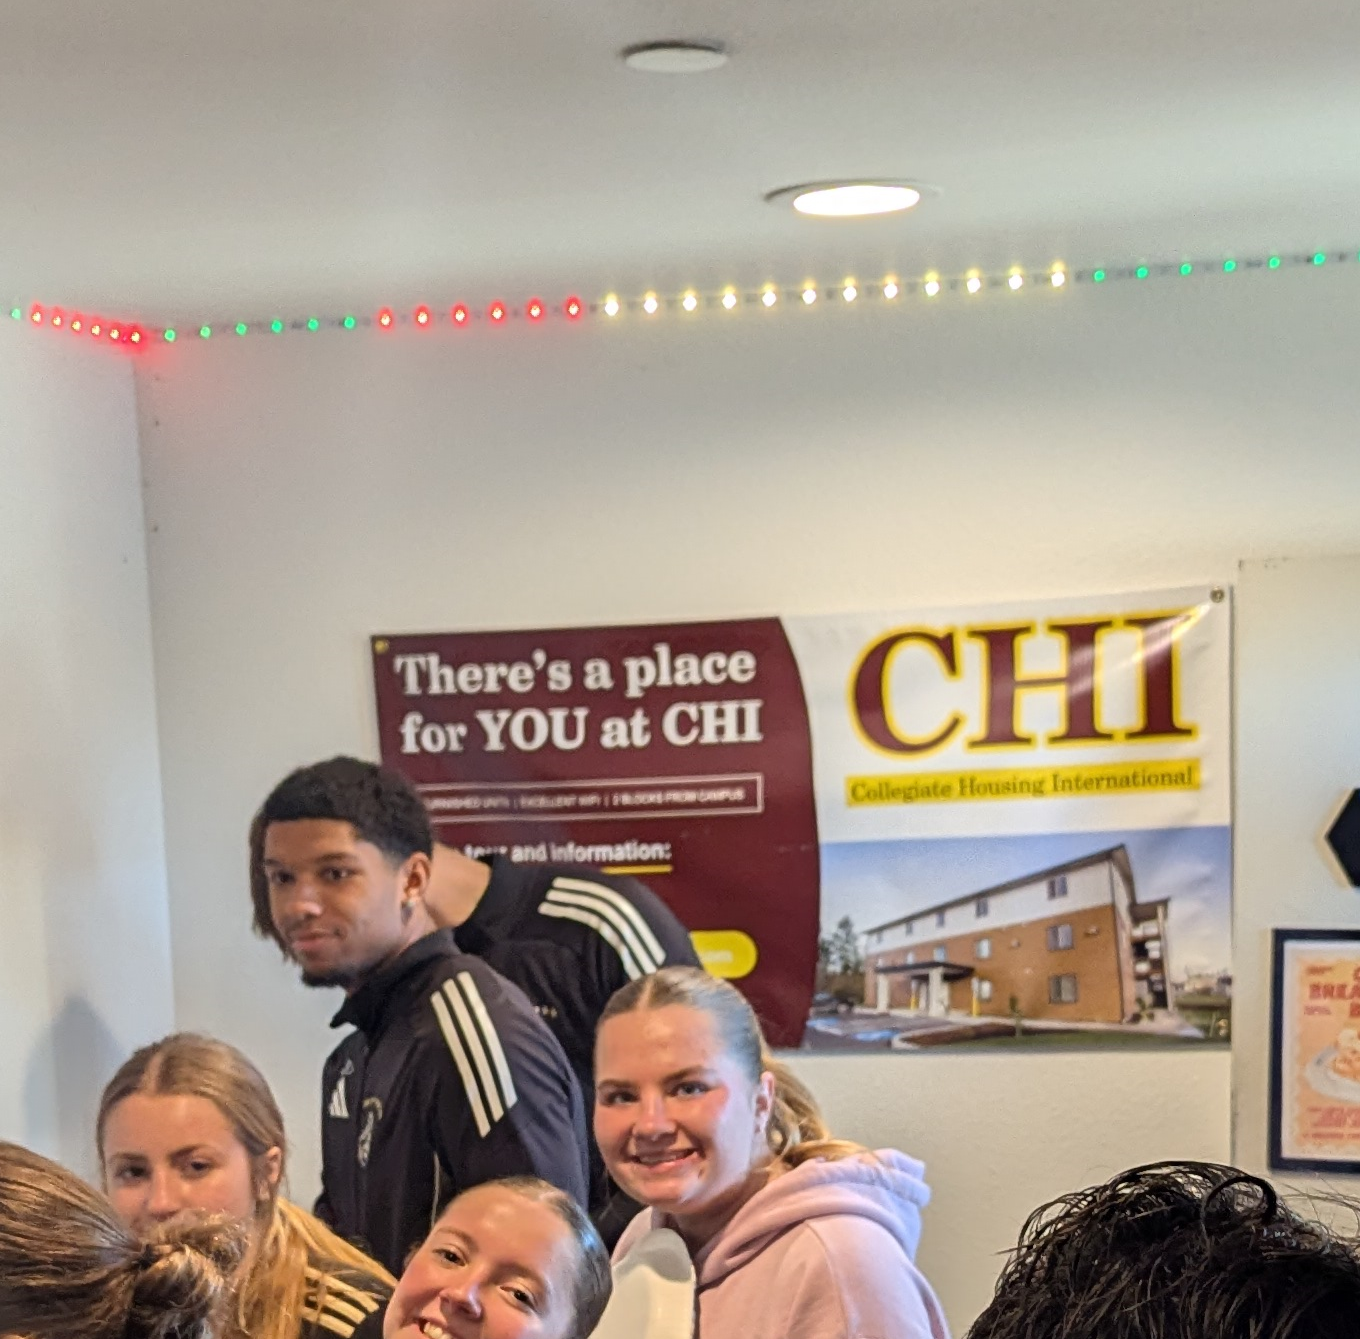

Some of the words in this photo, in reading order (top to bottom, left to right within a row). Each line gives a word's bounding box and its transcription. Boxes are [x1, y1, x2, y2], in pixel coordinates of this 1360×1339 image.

[394, 649, 572, 696] There's
[583, 657, 614, 690] a
[624, 643, 756, 697] place
[848, 610, 1196, 757] CHI
[401, 712, 467, 754] for
[475, 707, 589, 751] YOU
[601, 708, 651, 748] at
[662, 699, 763, 745] CHI
[850, 781, 952, 804] Collegiate
[958, 775, 1045, 797] Housing
[1051, 765, 1193, 792] International
[511, 842, 548, 862] and
[549, 838, 672, 862] information:
